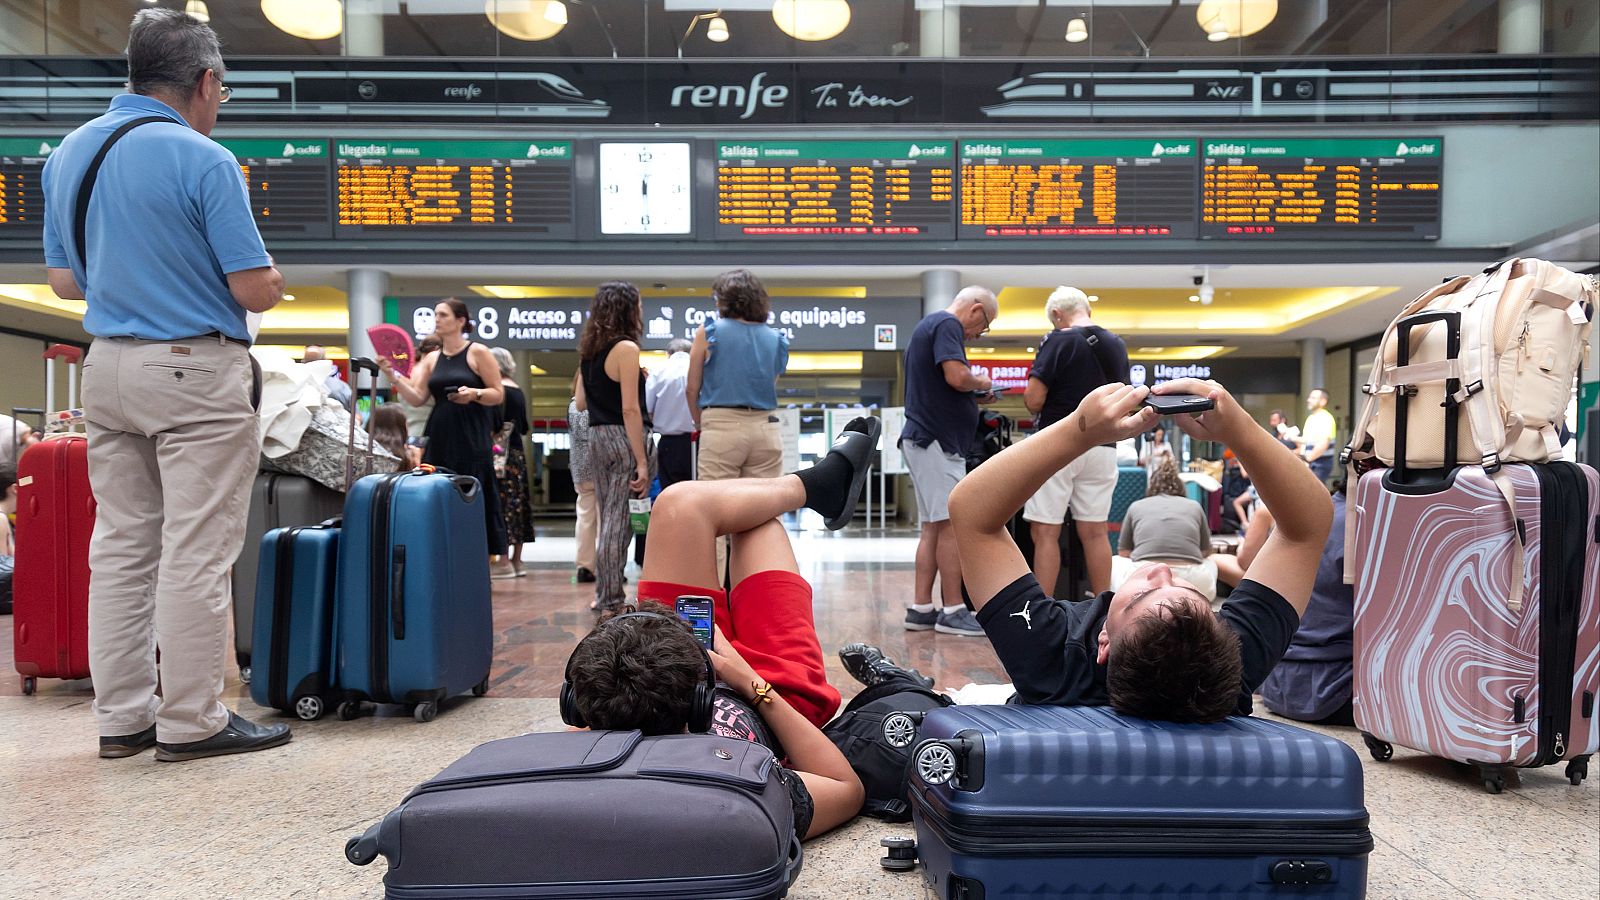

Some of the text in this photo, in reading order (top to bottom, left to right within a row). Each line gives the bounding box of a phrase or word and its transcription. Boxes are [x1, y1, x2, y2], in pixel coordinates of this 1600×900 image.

[444, 82, 482, 100] renfe
[670, 71, 790, 120] renfe
[810, 82, 914, 108] Tu tren
[1206, 86, 1244, 98] AVE
[339, 144, 388, 158] Llegadas
[721, 145, 759, 157] Salidas
[964, 144, 1002, 156] Salidas
[1207, 143, 1246, 156] Salidas
[508, 307, 563, 325] Acceso
[570, 310, 582, 325] a
[780, 306, 866, 328] equipajes
[508, 328, 575, 339] PLATFORMS
[970, 364, 1028, 380] No pasar
[1154, 364, 1211, 379] Llegadas
